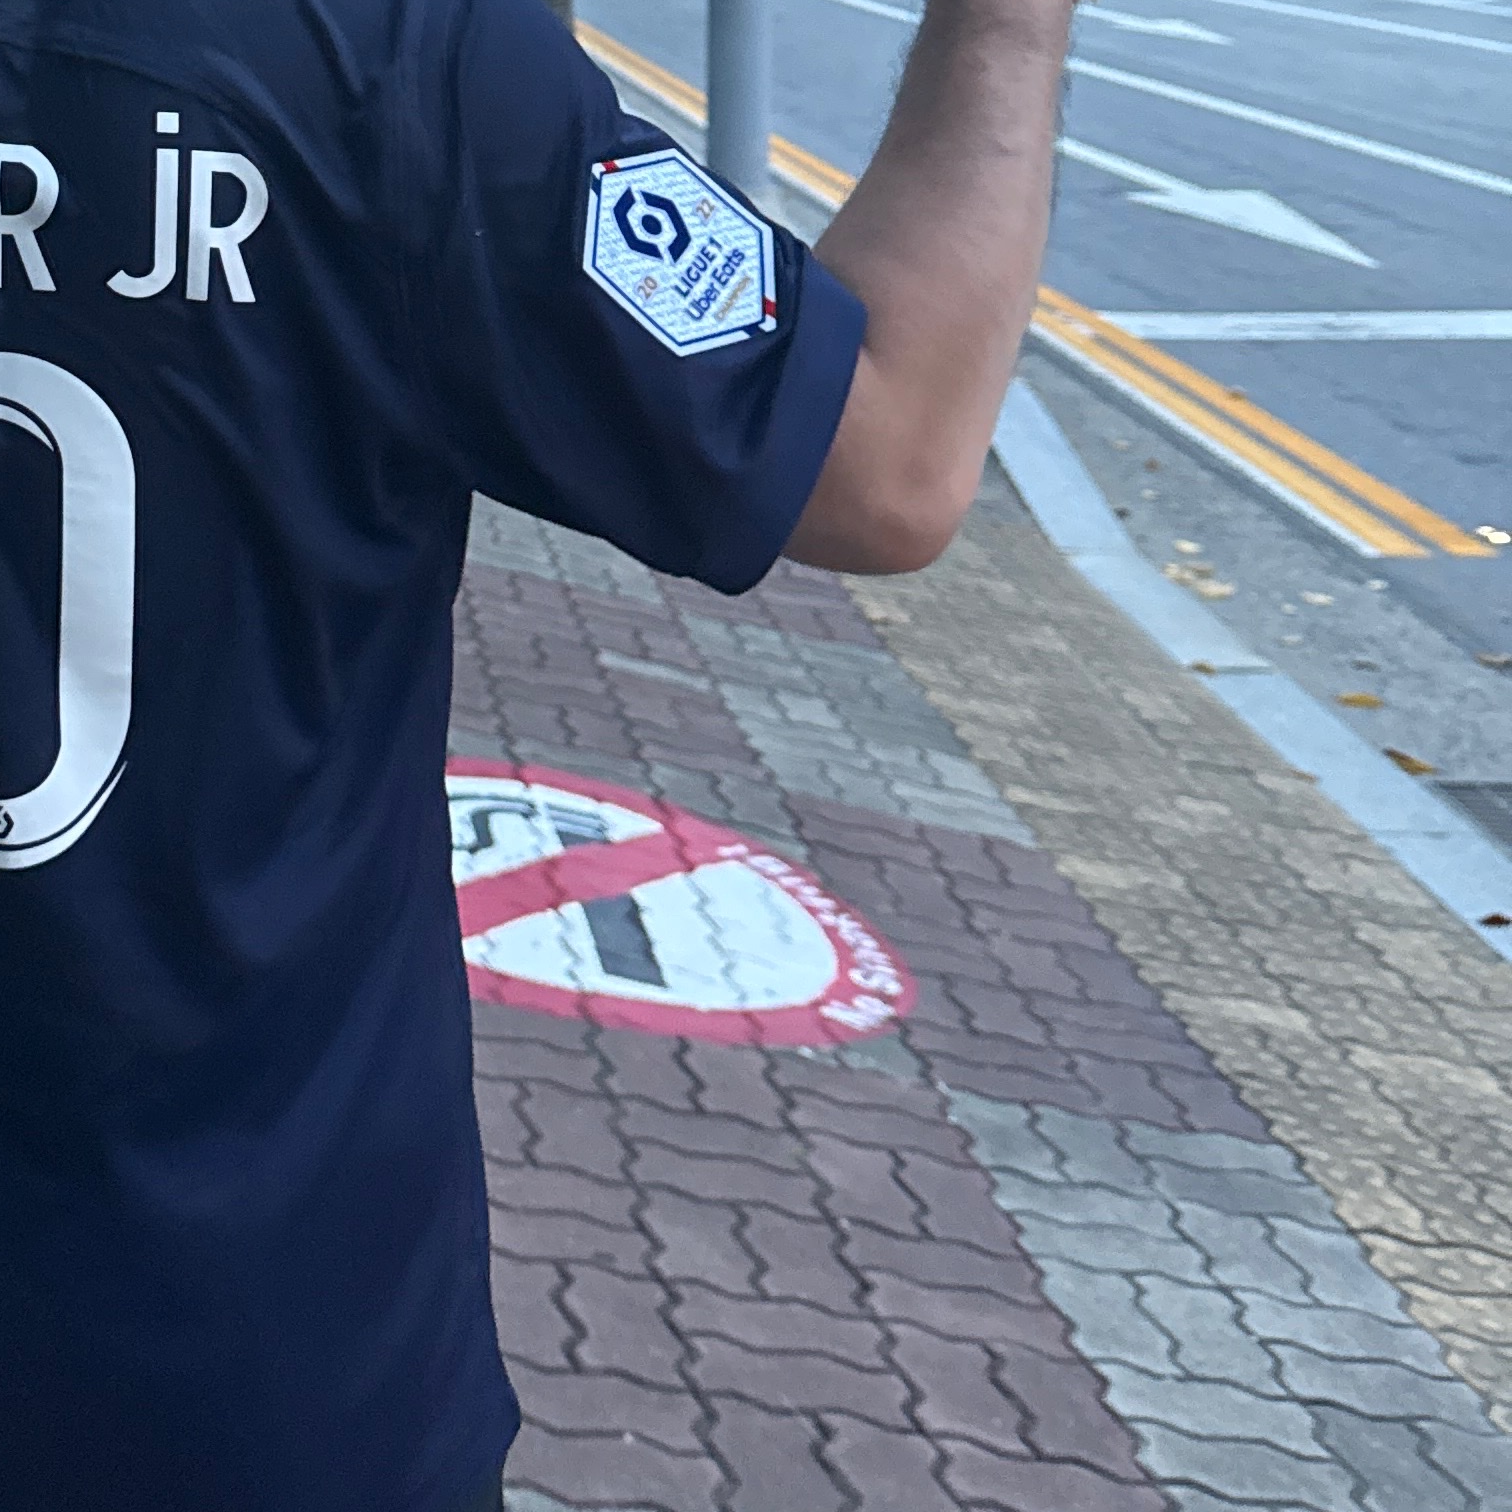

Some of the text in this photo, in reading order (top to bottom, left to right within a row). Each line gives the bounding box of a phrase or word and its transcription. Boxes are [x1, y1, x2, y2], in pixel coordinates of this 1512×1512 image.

[637, 198, 716, 299] 20 22
[672, 235, 722, 298] LIGUE 1
[686, 248, 746, 321] Uber Eats
[714, 275, 751, 321] CHAMPION
[817, 994, 898, 1031] No
